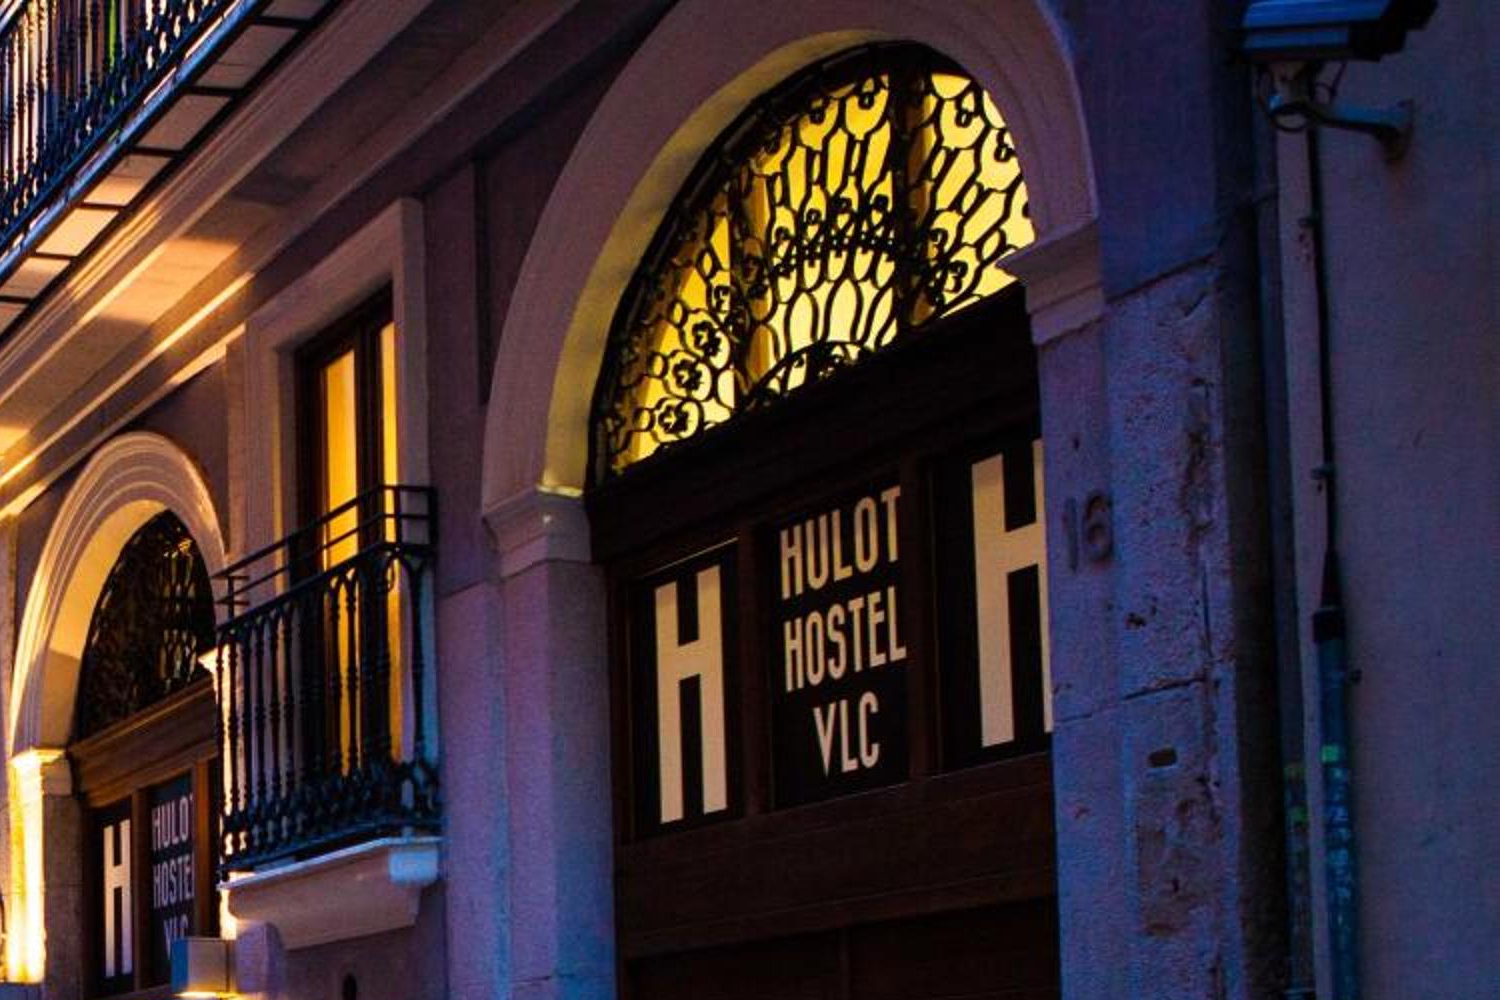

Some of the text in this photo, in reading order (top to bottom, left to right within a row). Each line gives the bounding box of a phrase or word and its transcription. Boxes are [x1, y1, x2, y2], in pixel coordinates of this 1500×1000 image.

[780, 485, 901, 600] HULOT
[971, 438, 1053, 748] H
[655, 565, 727, 824] H
[784, 586, 907, 693] HOSTEL
[813, 691, 880, 777] VLC
[104, 819, 133, 979] H
